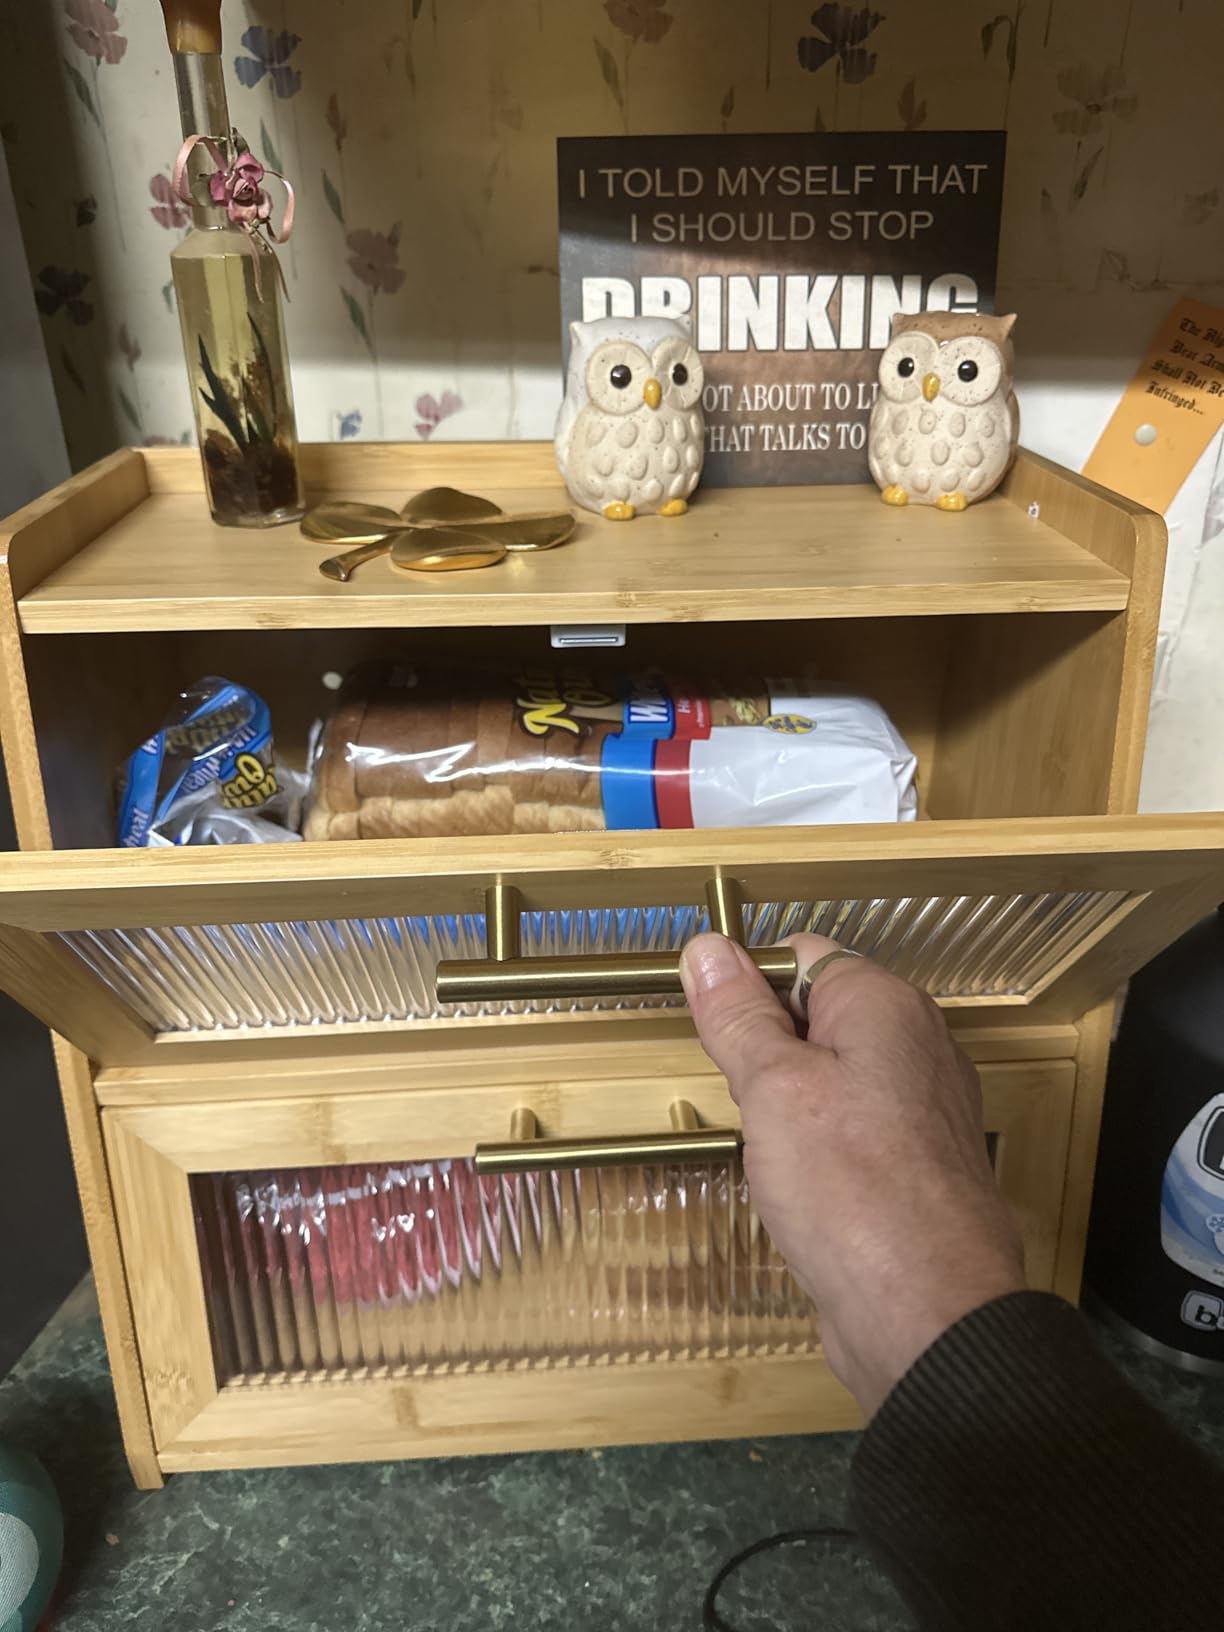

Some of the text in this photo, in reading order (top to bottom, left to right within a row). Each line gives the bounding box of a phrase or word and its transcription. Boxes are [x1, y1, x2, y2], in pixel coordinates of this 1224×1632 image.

[578, 163, 989, 199] I TOLD MYSELF THAT
[630, 209, 935, 244] I SHOULD STOP
[702, 384, 733, 412] OT
[736, 384, 818, 413] ABOUT
[820, 383, 852, 412] TO
[759, 423, 832, 452] TALKS
[835, 422, 867, 450] TO
